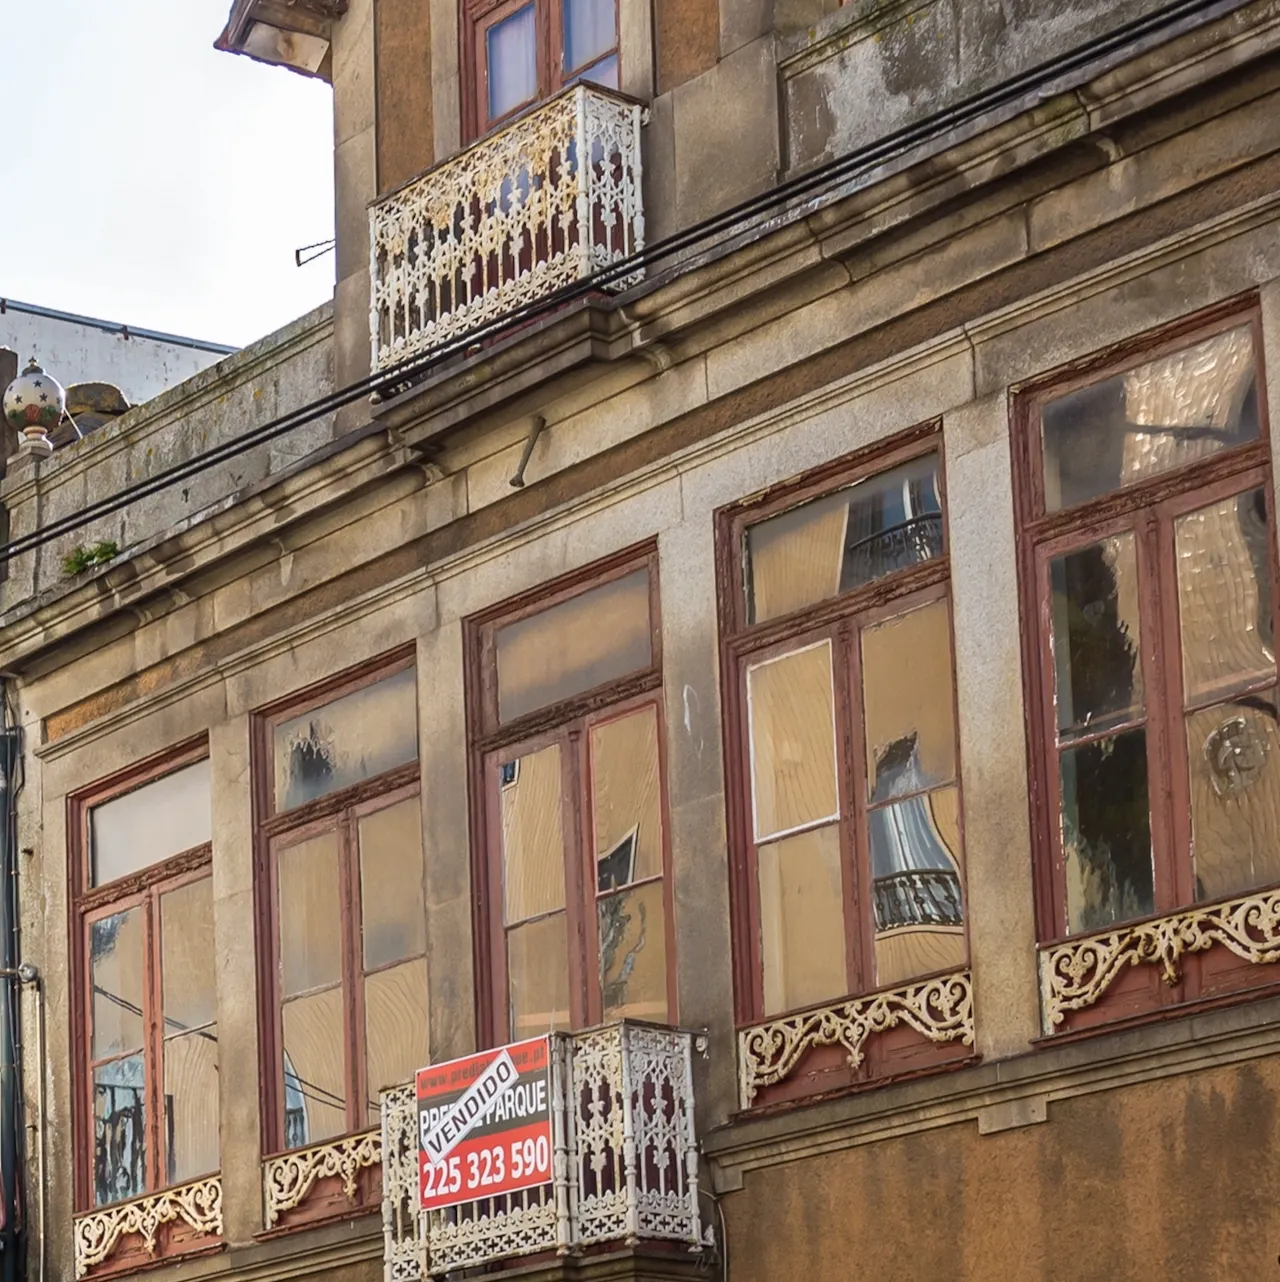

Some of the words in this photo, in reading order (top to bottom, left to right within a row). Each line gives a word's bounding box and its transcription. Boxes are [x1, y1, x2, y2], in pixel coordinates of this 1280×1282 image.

[428, 1061, 511, 1154] VENDIDO
[423, 1156, 461, 1198] 225
[467, 1146, 505, 1189] 323
[511, 1135, 549, 1179] 590
